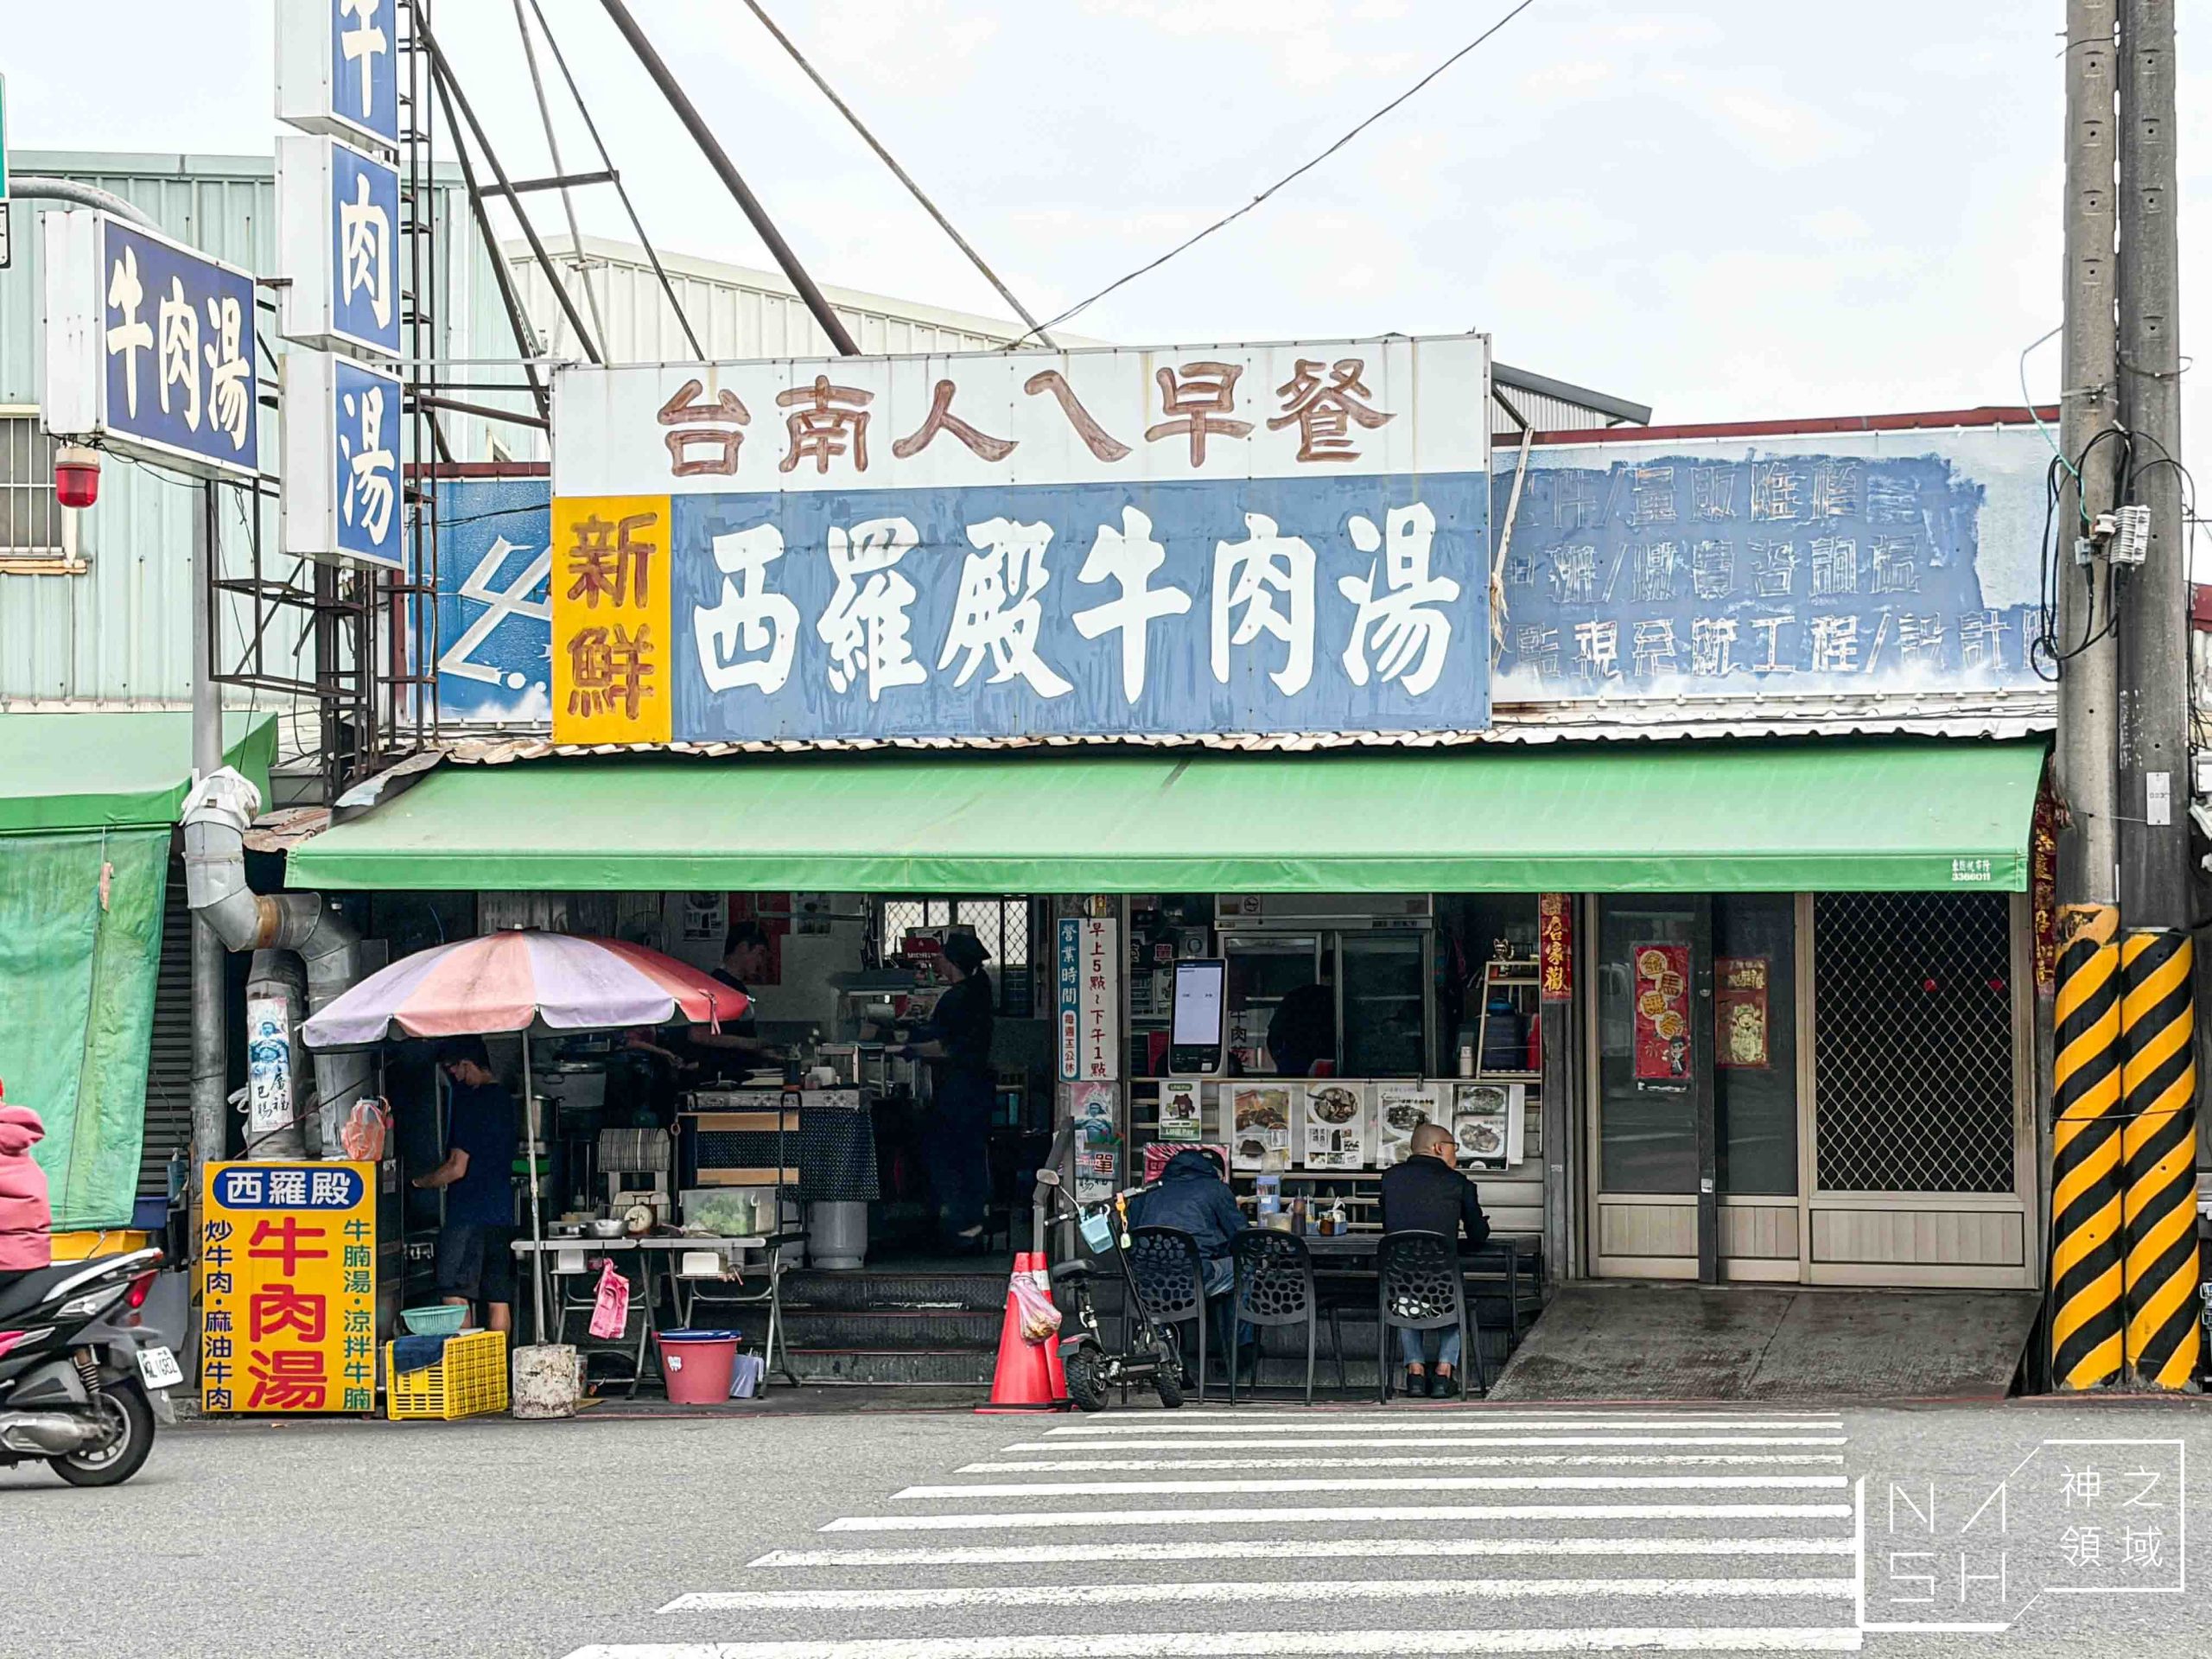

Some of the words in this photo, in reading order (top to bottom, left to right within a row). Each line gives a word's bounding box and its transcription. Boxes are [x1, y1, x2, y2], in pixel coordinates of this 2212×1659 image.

[106, 245, 251, 452] 牛肉湯
[567, 512, 658, 721] 新鮮
[693, 502, 1461, 705] 西羅殿牛肉湯
[1061, 924, 1077, 1005] 營業時間
[226, 1171, 351, 1205] 西羅殿
[247, 1217, 328, 1410] 牛肉湯
